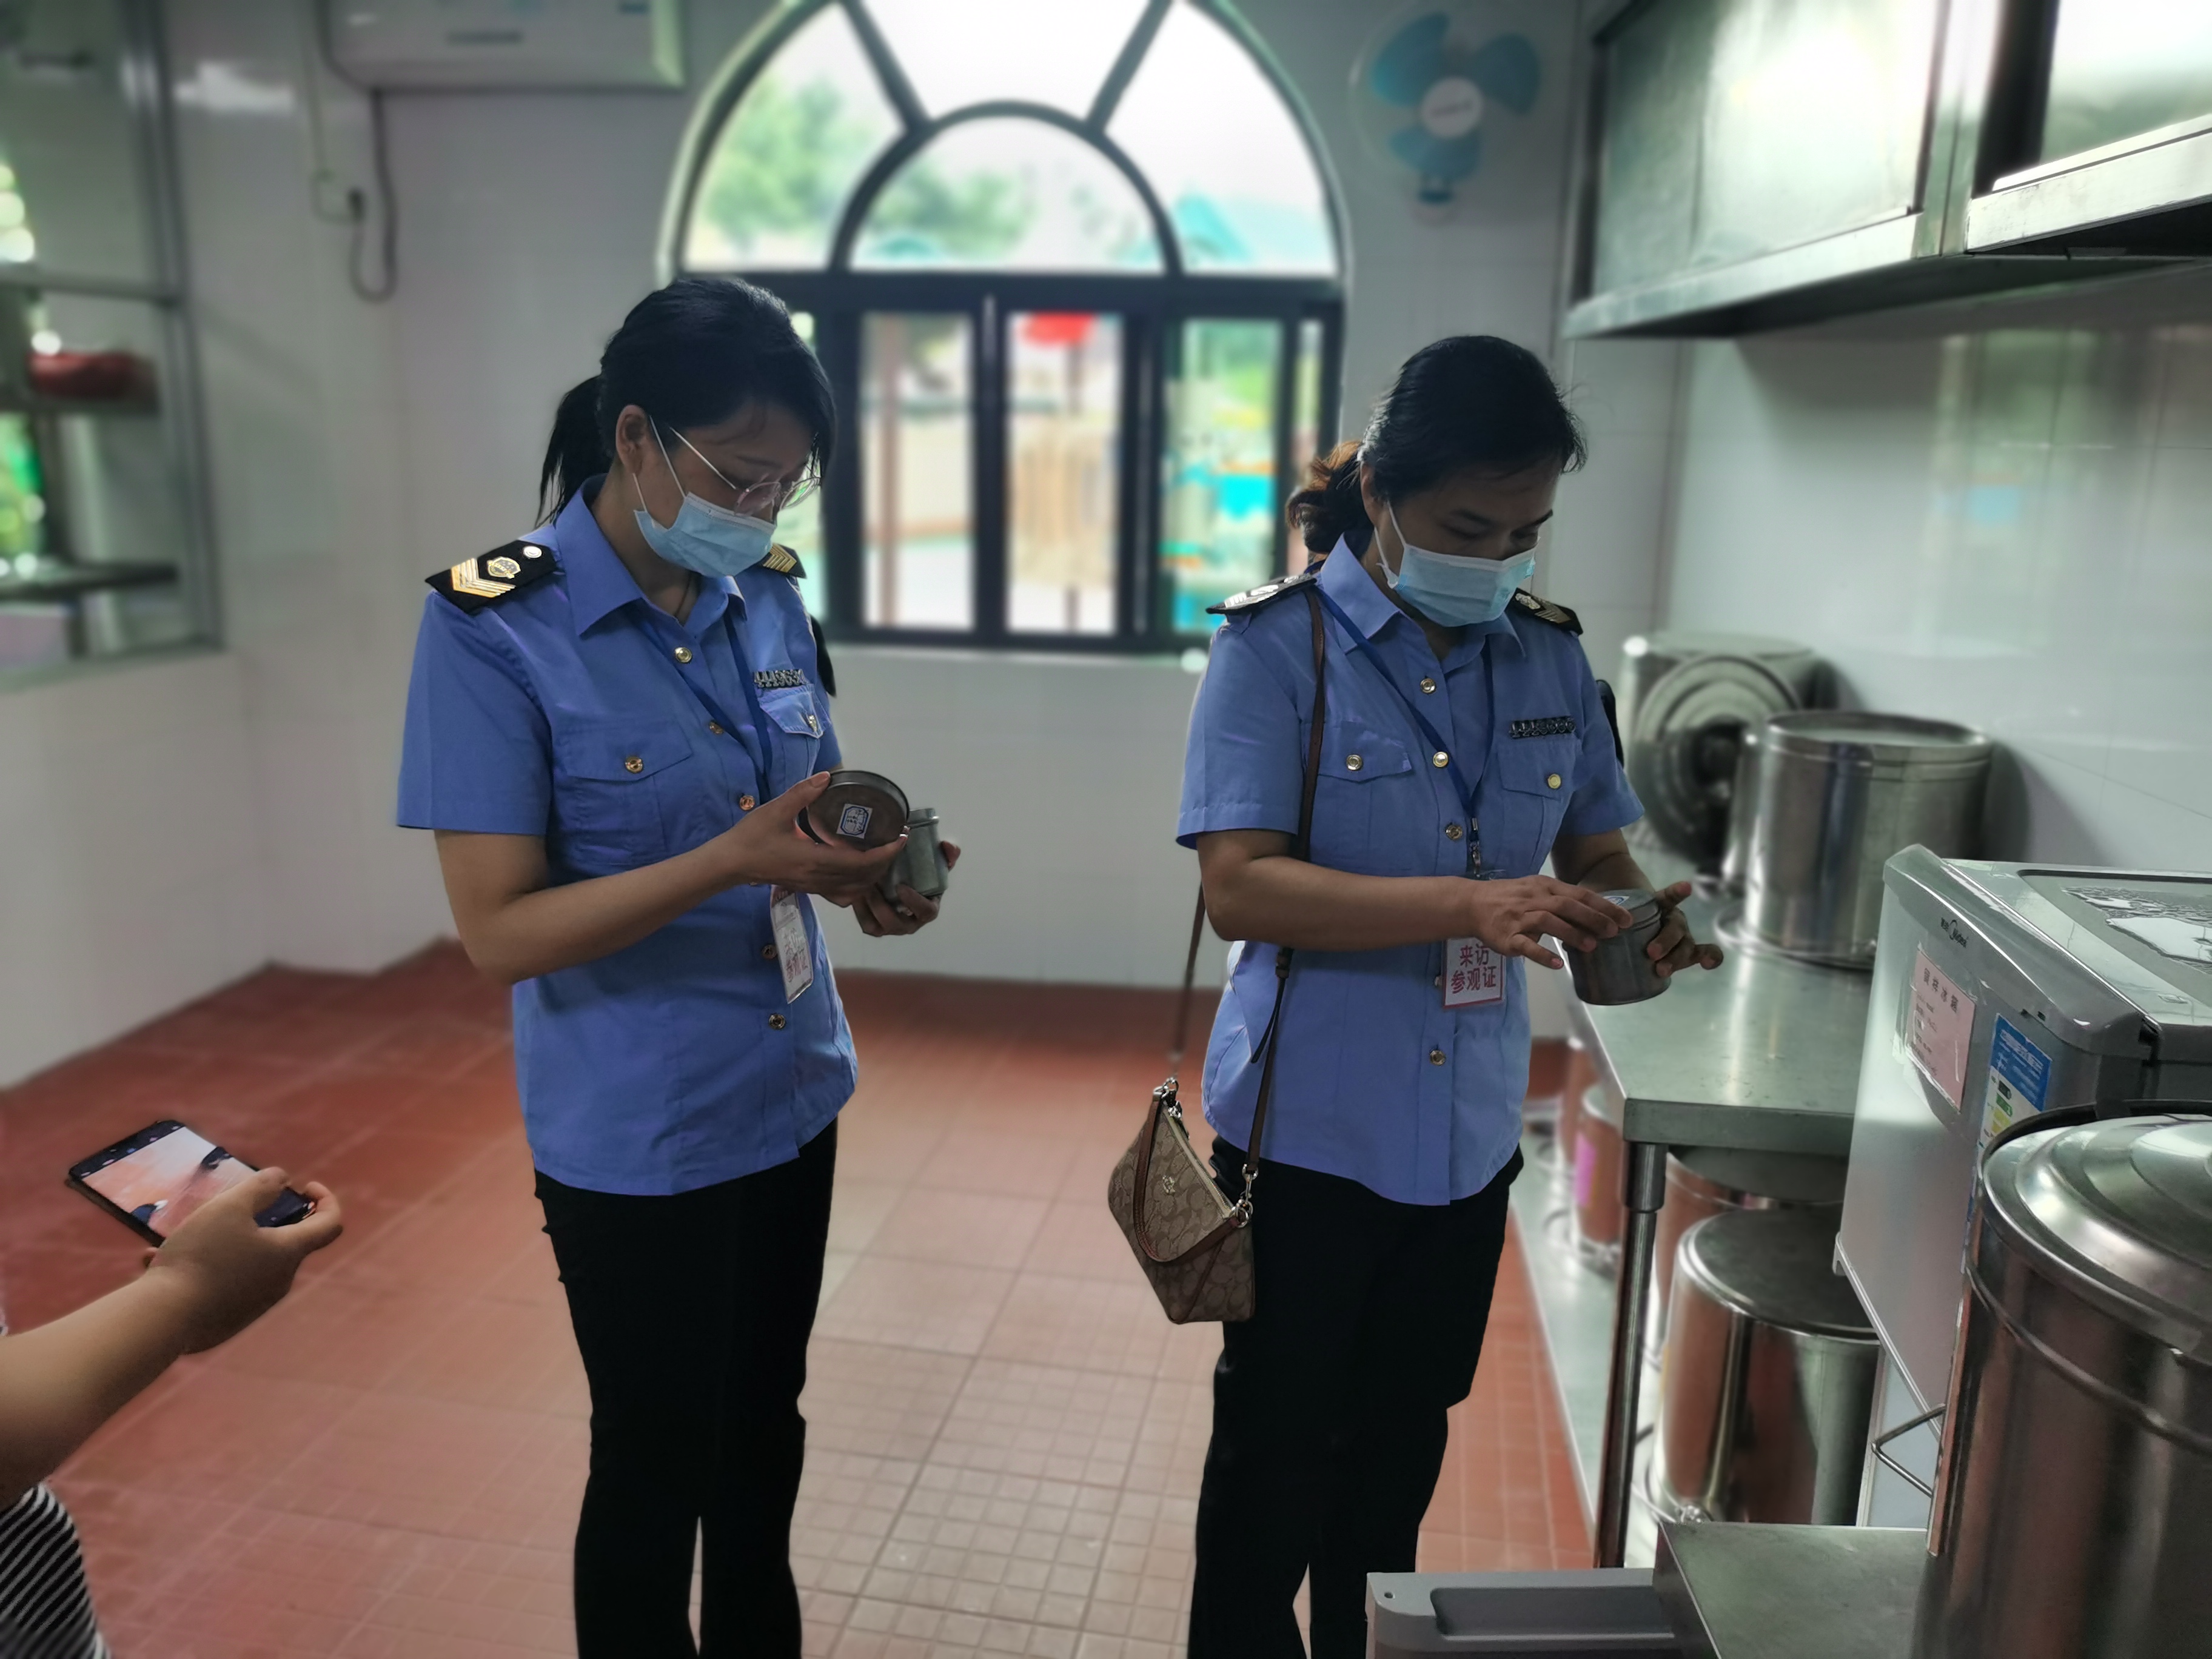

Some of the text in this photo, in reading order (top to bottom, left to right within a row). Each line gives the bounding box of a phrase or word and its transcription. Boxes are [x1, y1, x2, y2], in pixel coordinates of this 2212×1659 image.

[1460, 943, 1491, 968] 来访
[1450, 965, 1497, 994] 参观证
